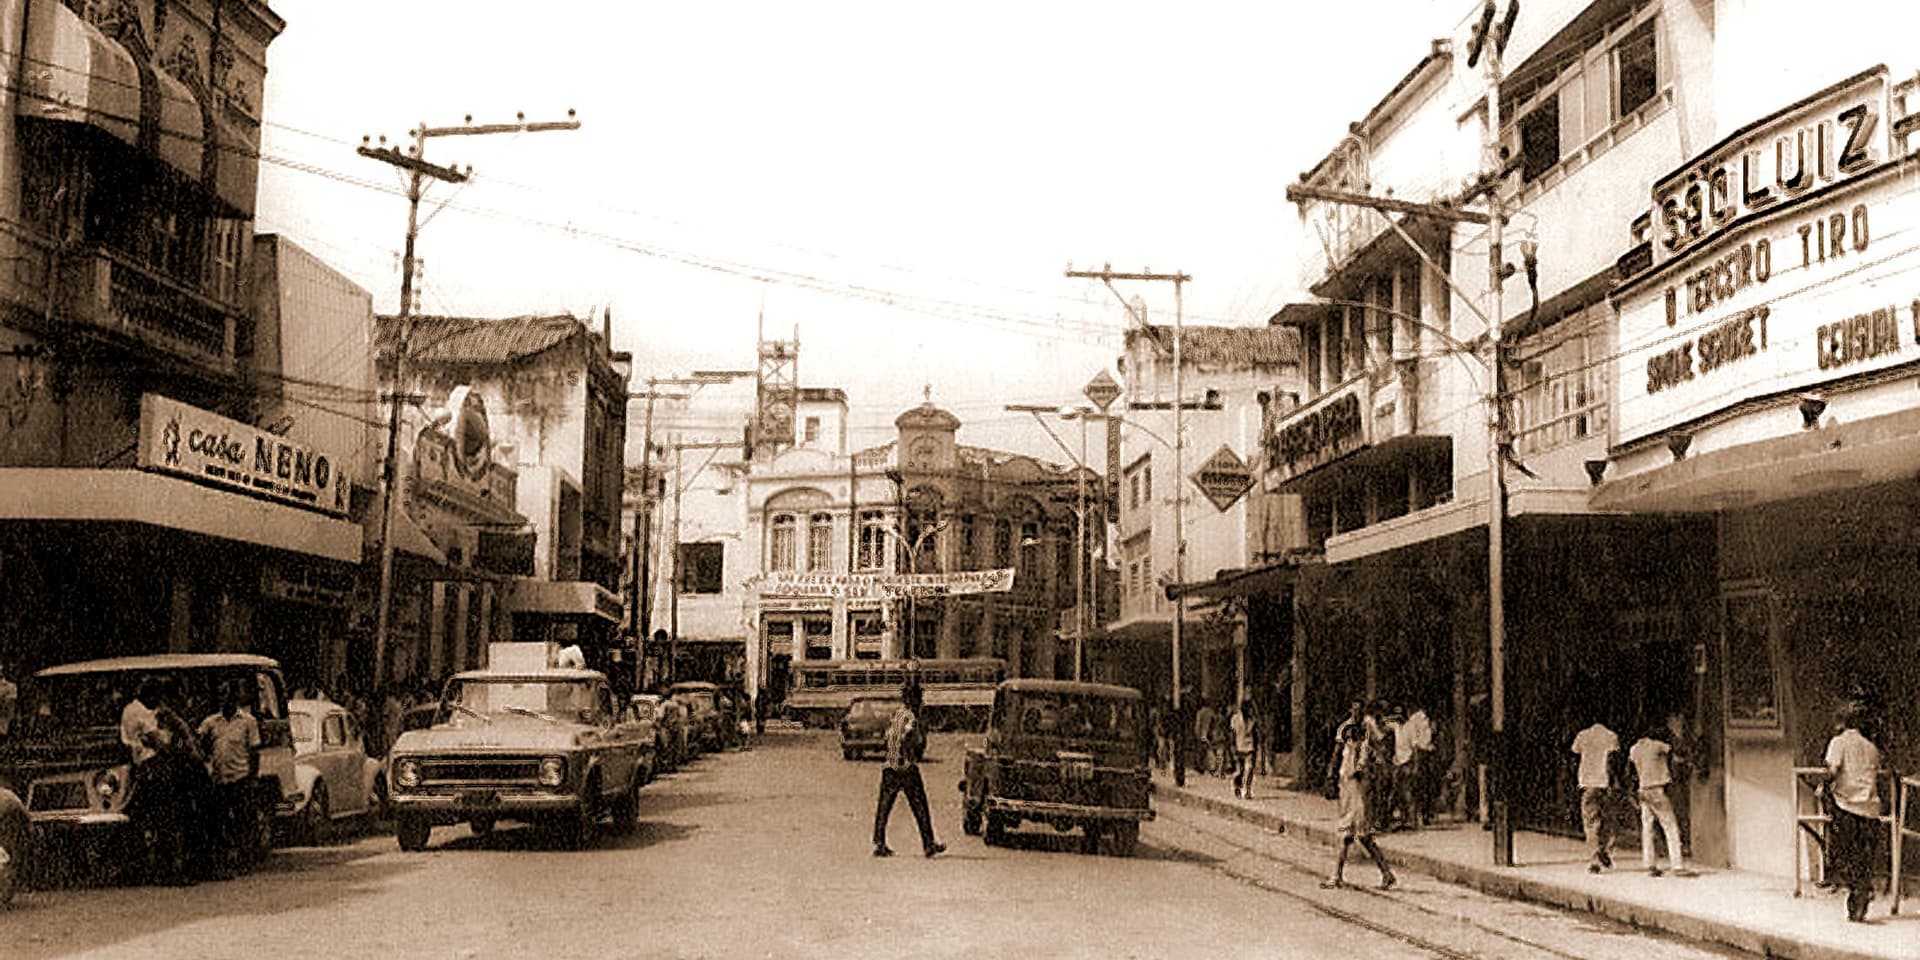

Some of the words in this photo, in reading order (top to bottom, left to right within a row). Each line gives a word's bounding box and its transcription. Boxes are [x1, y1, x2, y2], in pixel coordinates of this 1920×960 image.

[1742, 103, 1878, 210] LUIZ
[1797, 203, 1869, 269] TIRO
[189, 428, 246, 465] casa
[254, 435, 330, 490] NENO
